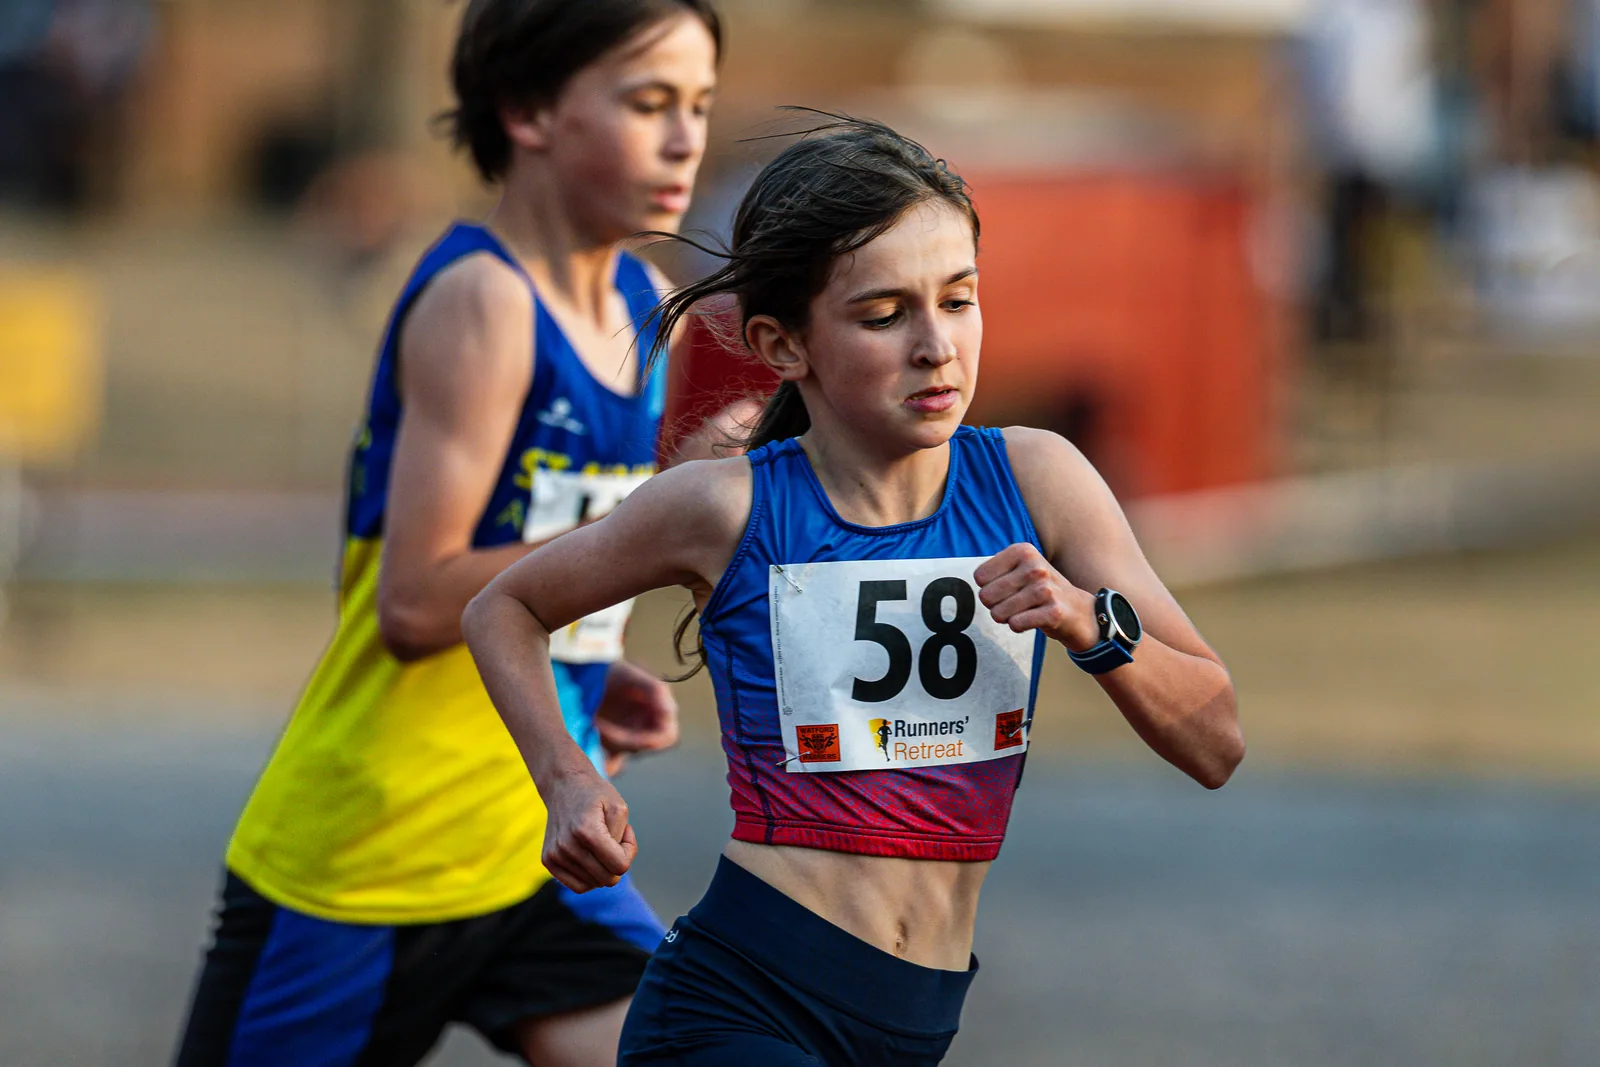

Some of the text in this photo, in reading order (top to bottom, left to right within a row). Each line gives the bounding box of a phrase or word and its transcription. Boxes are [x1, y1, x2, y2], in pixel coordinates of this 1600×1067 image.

[851, 576, 977, 702] 58
[799, 726, 835, 734] WATFORD
[893, 739, 964, 761] Retreat
